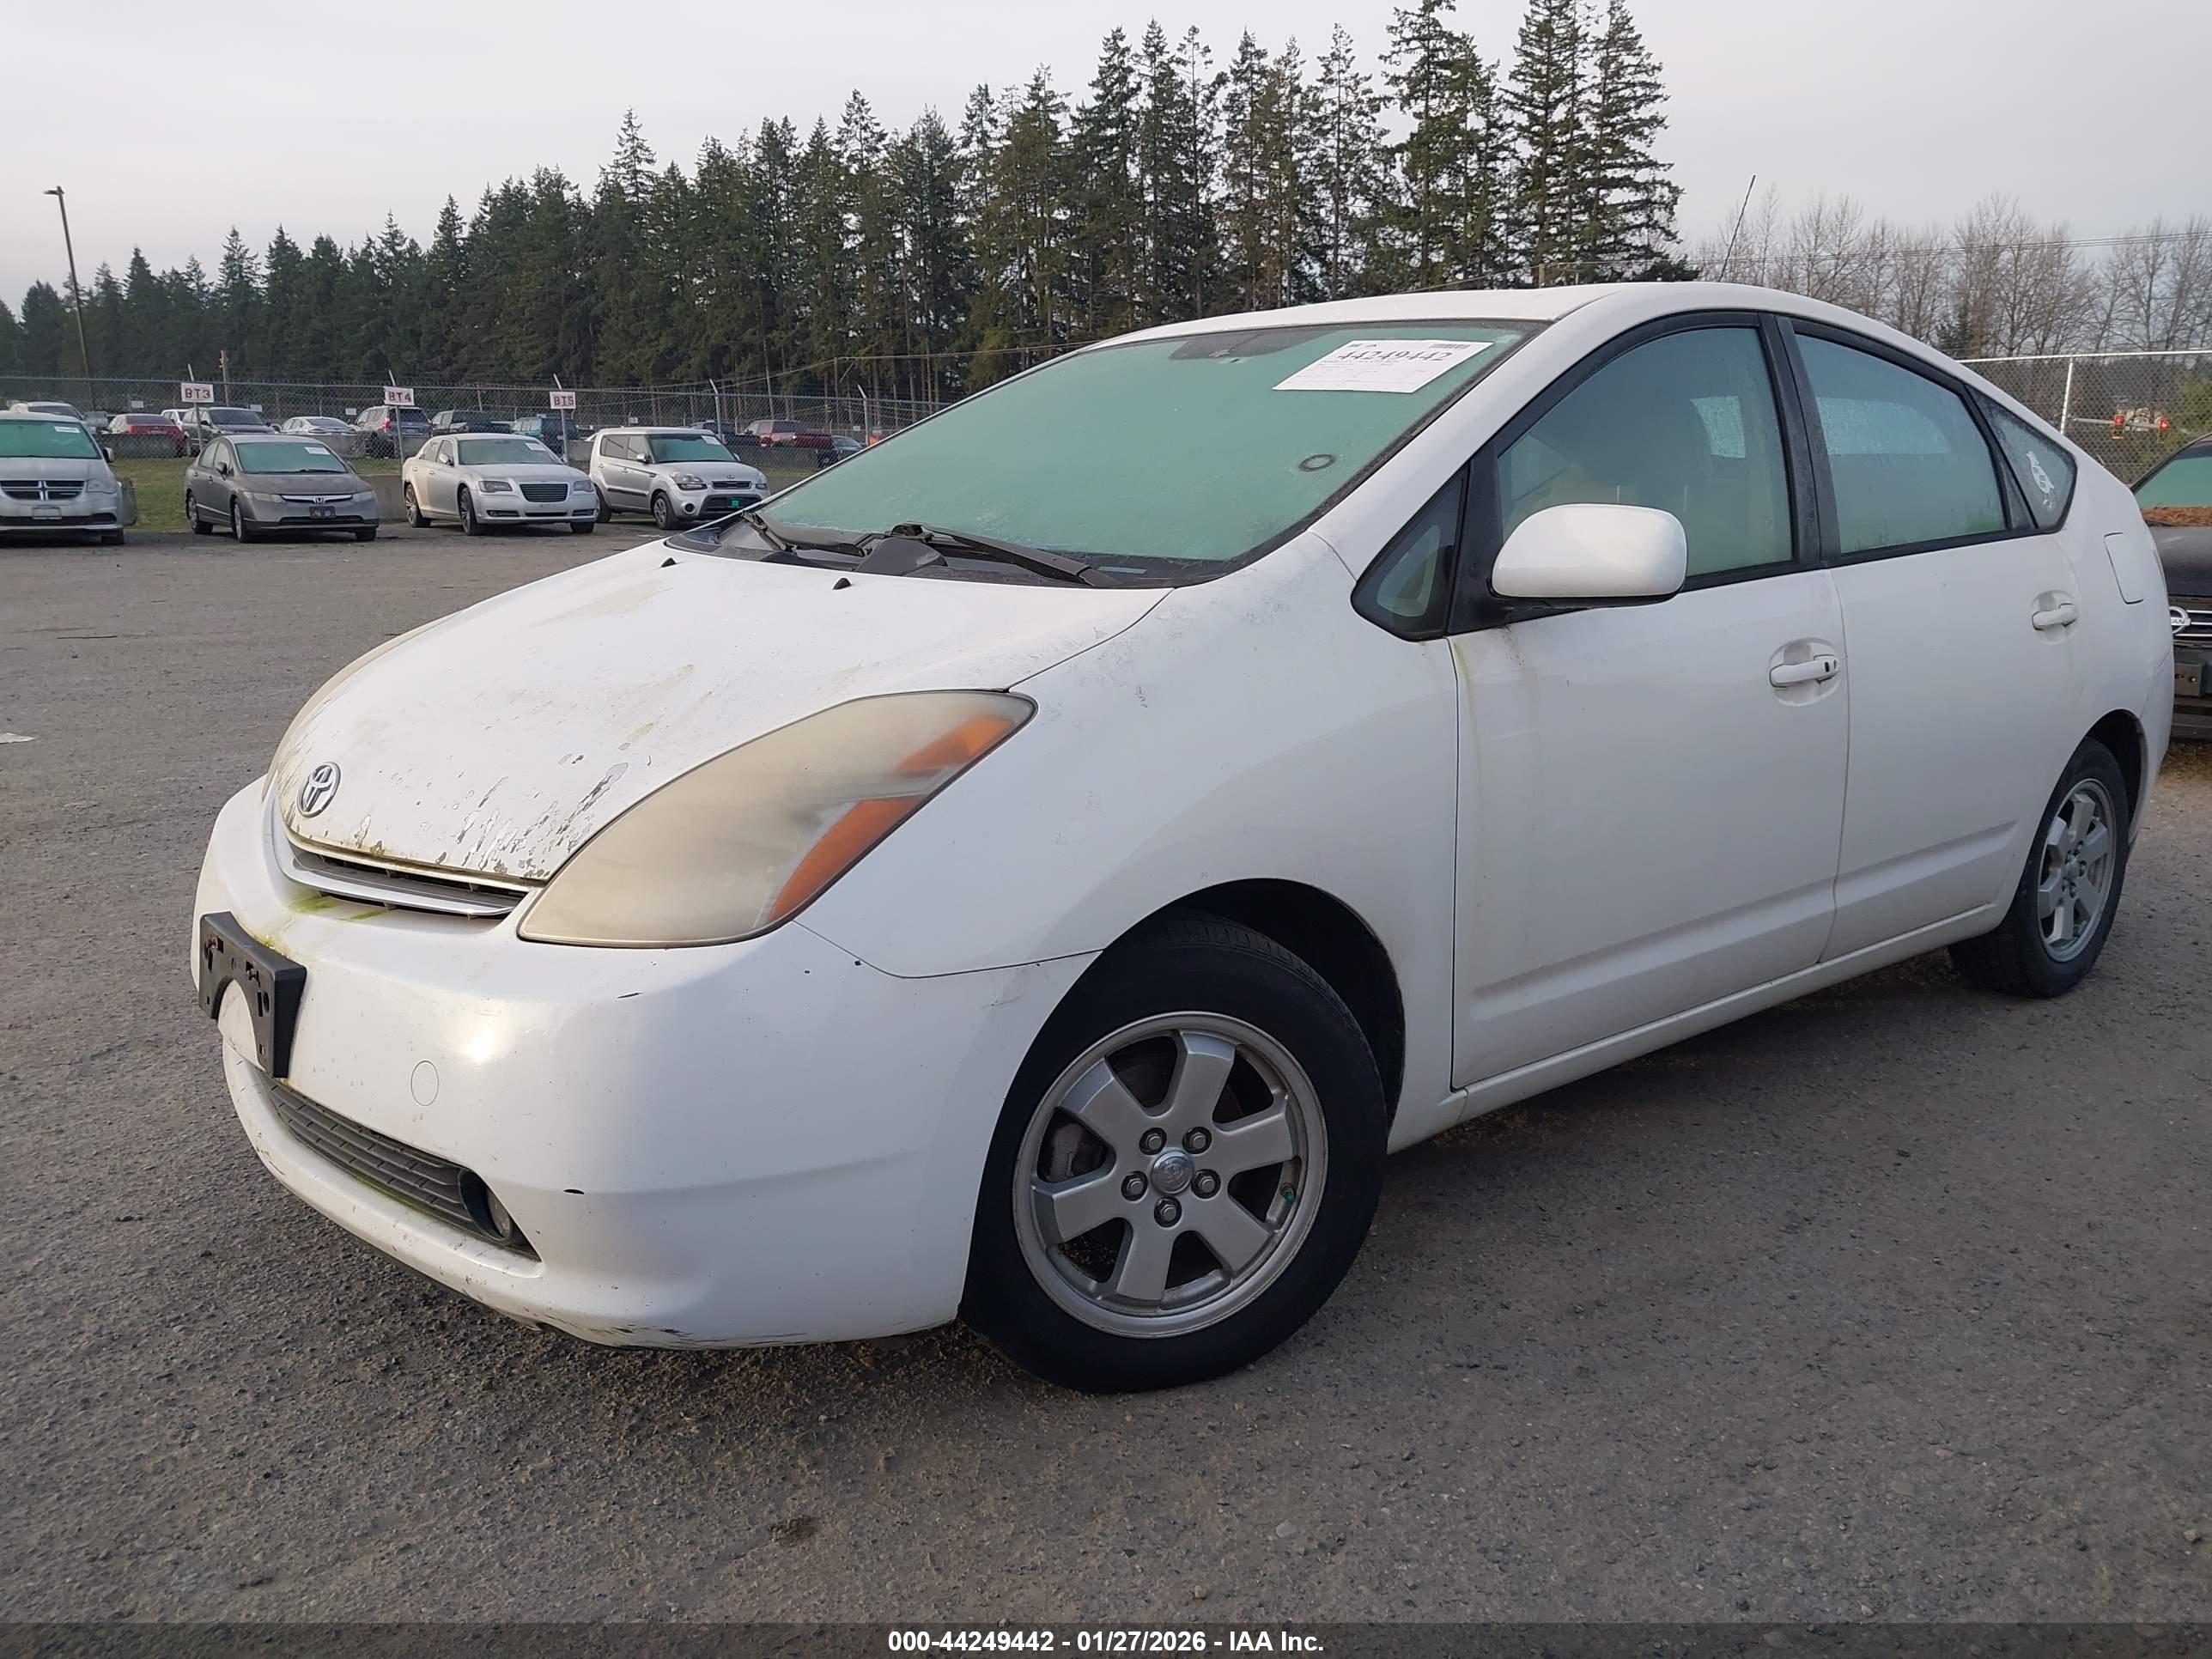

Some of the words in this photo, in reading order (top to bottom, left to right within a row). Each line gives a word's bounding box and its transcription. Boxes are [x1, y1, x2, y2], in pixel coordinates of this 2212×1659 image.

[1337, 350, 1453, 362] 44249442
[185, 388, 211, 399] BT3
[388, 392, 411, 402] BT4
[554, 396, 574, 406] BT5
